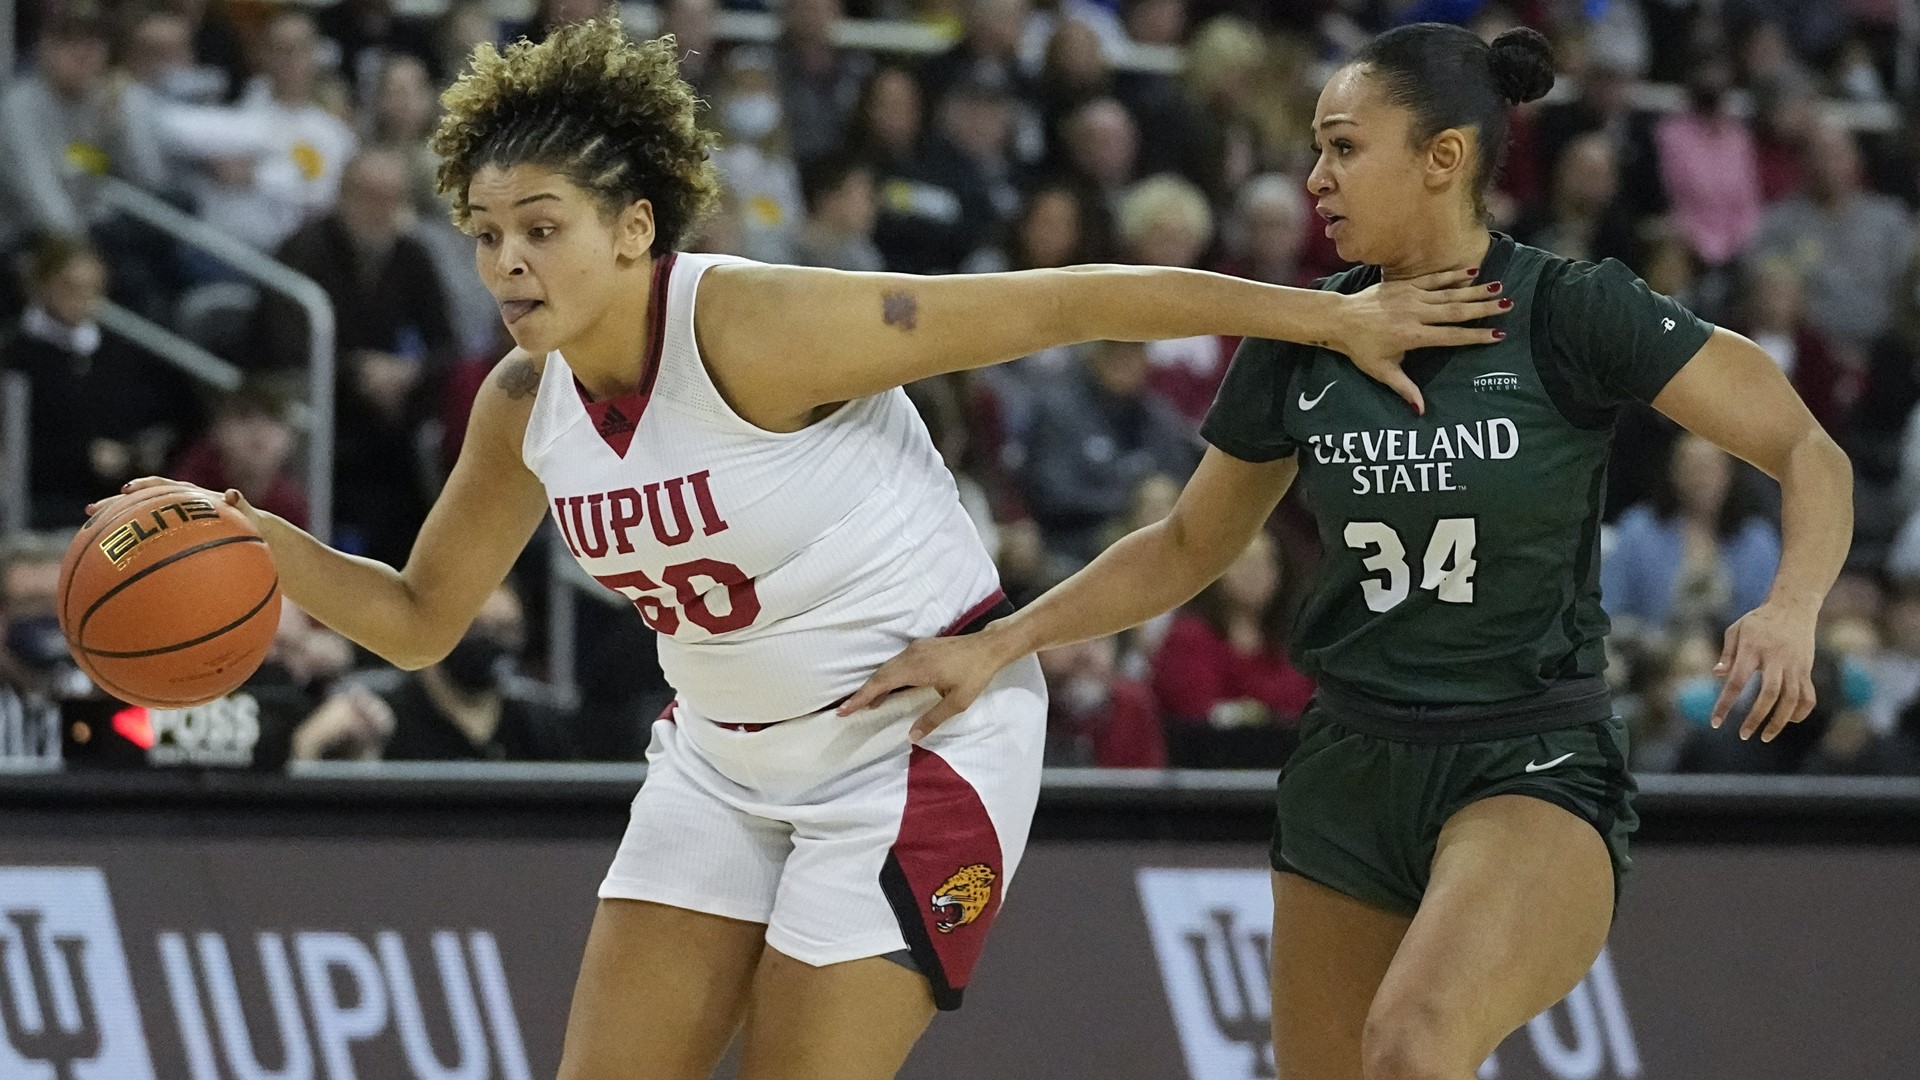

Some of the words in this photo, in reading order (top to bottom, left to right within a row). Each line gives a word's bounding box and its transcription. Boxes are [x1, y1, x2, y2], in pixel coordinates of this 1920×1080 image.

[1473, 376, 1518, 387] HORIZON
[1308, 417, 1519, 465] CLEVELAND
[1352, 462, 1457, 495] STATE
[99, 499, 221, 565] ELITE
[554, 469, 729, 559] IUPUI
[1343, 517, 1477, 613] 34
[155, 928, 534, 1080] IUPUI
